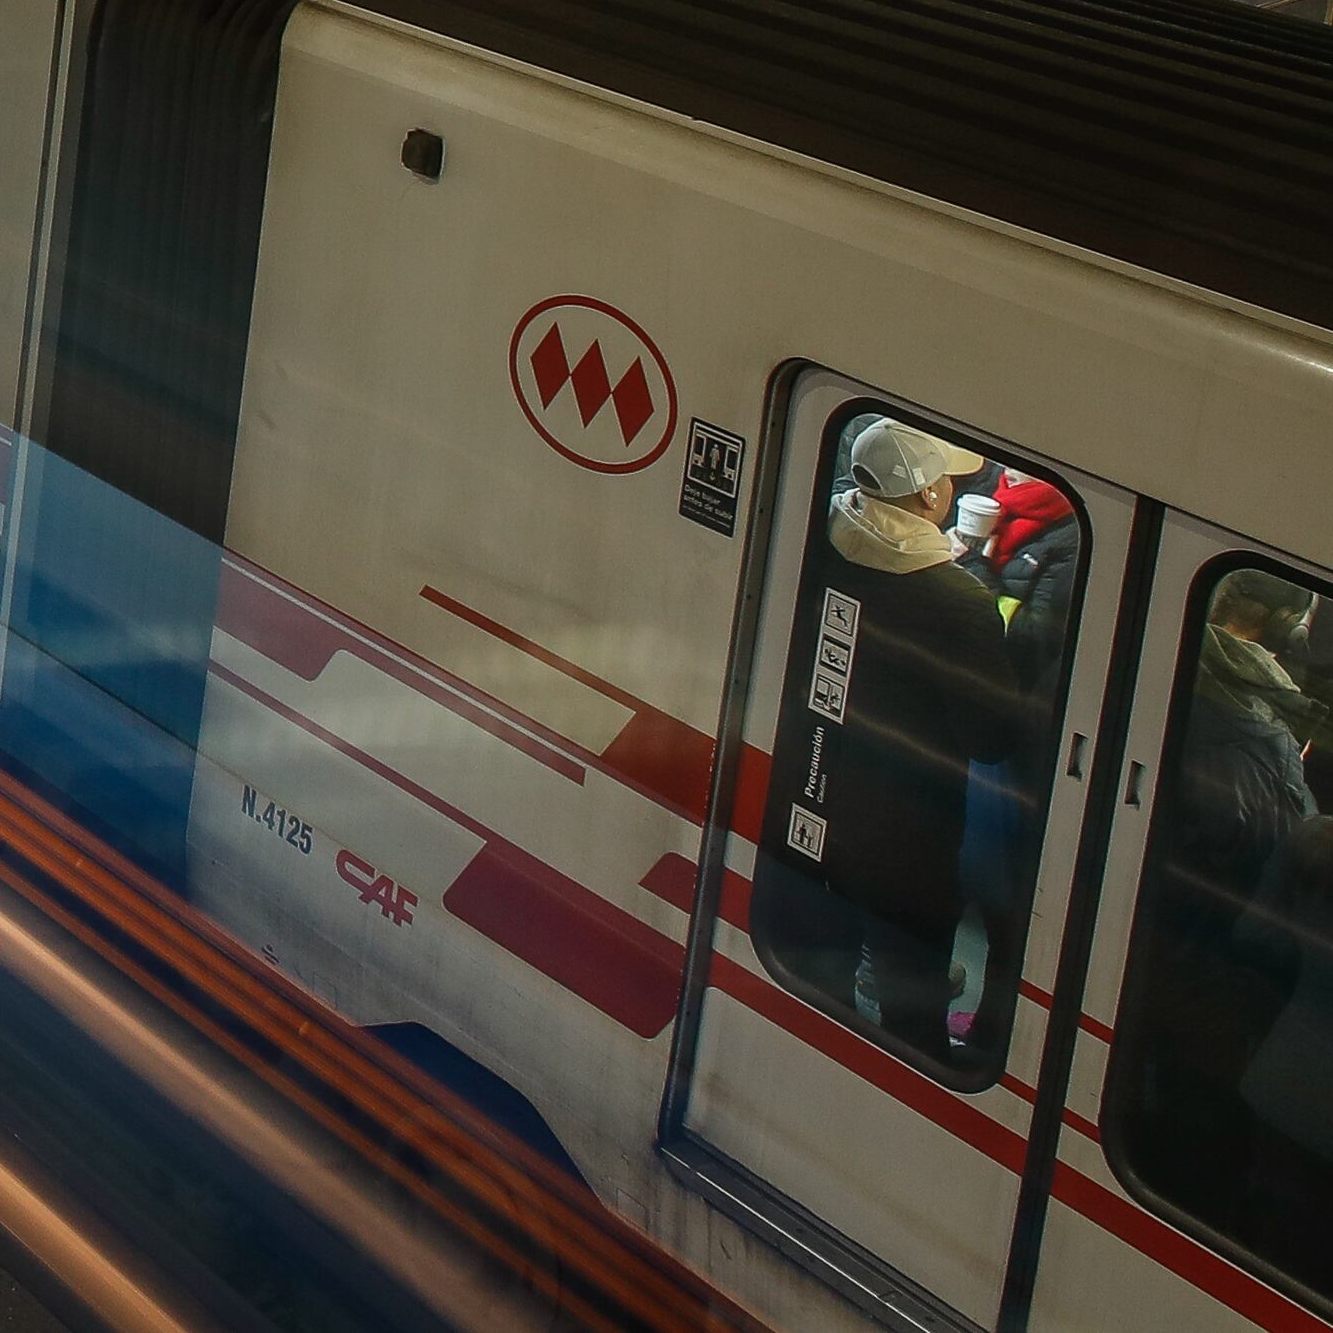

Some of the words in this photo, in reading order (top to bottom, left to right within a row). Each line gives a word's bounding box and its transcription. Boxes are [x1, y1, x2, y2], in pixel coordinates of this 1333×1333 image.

[804, 726, 825, 798] Precaución
[241, 785, 313, 854] N.4125
[336, 849, 420, 927] CAF
